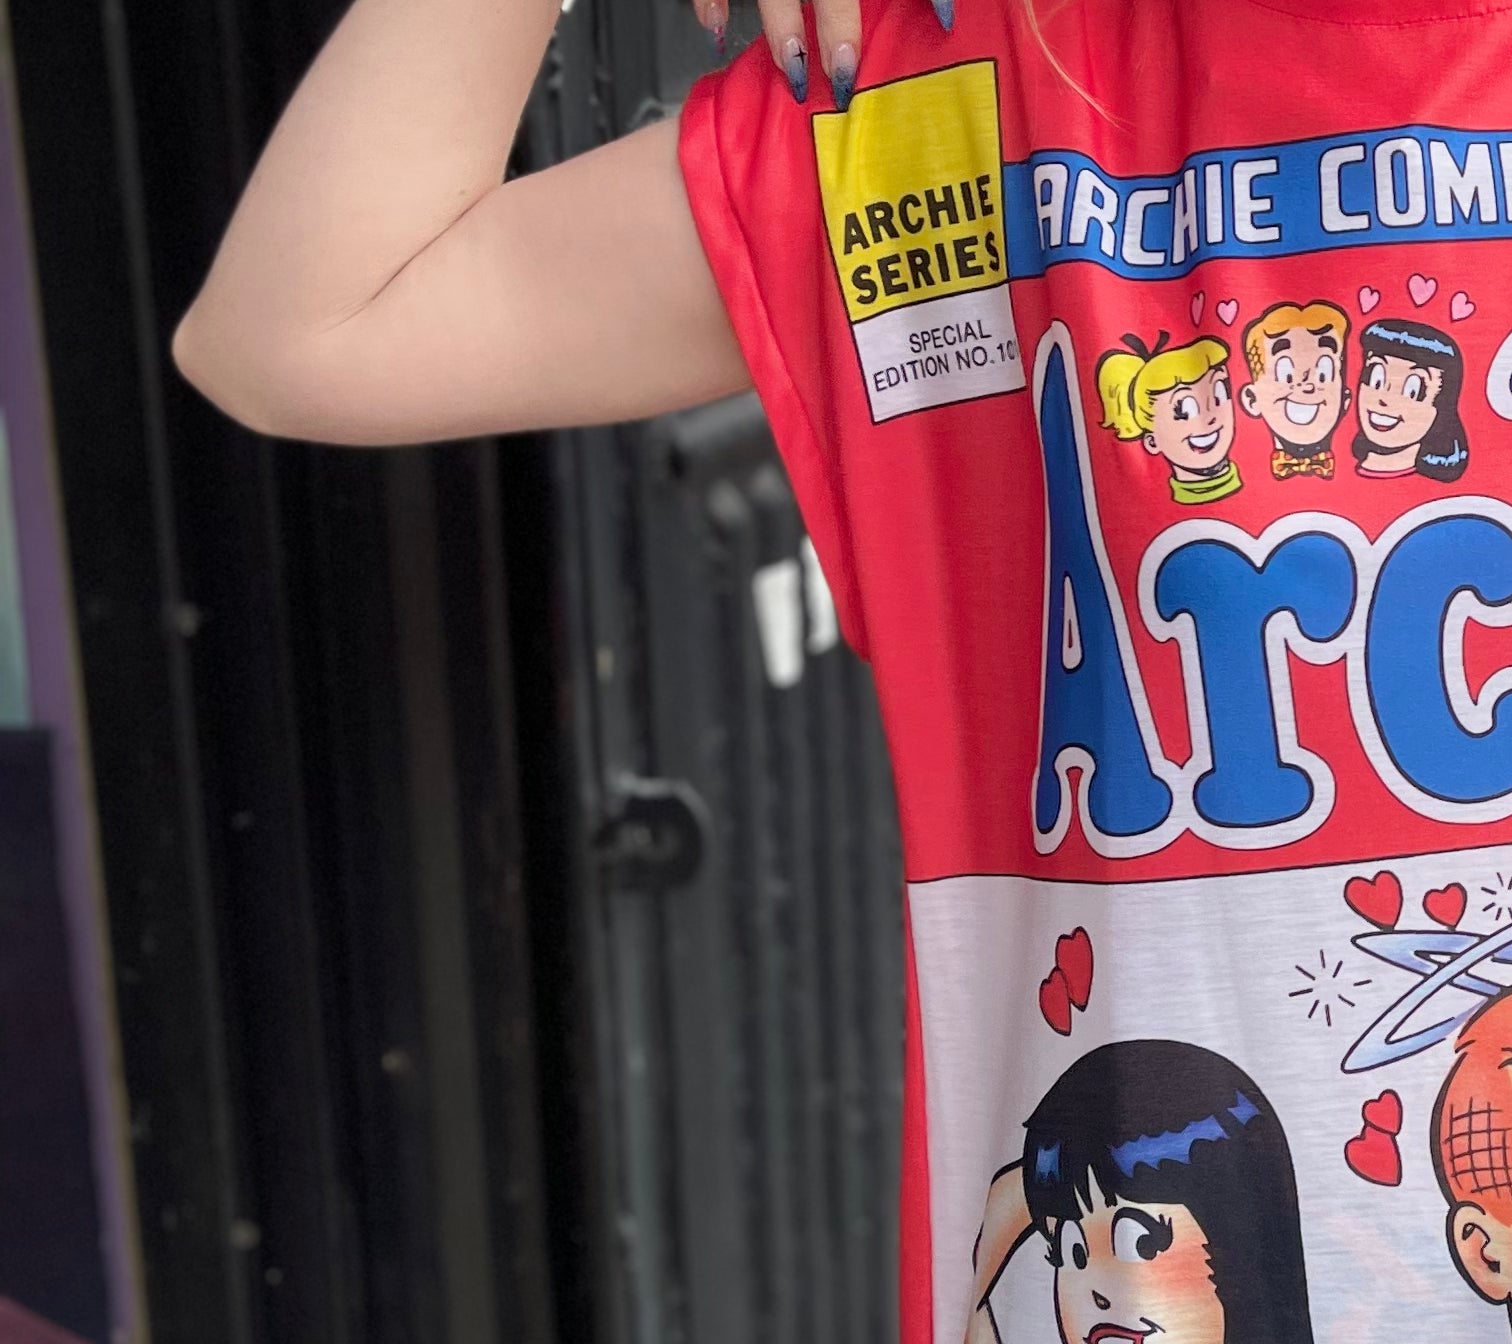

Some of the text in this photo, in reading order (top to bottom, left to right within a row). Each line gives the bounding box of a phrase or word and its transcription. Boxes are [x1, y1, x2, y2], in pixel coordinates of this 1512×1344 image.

[843, 174, 996, 256] ARCHIE
[1032, 156, 1282, 267] ARCHIE
[850, 230, 1001, 306] SERIES
[872, 353, 950, 393] EDITION
[955, 345, 996, 371] NO.
[909, 319, 993, 354] SPECIAL
